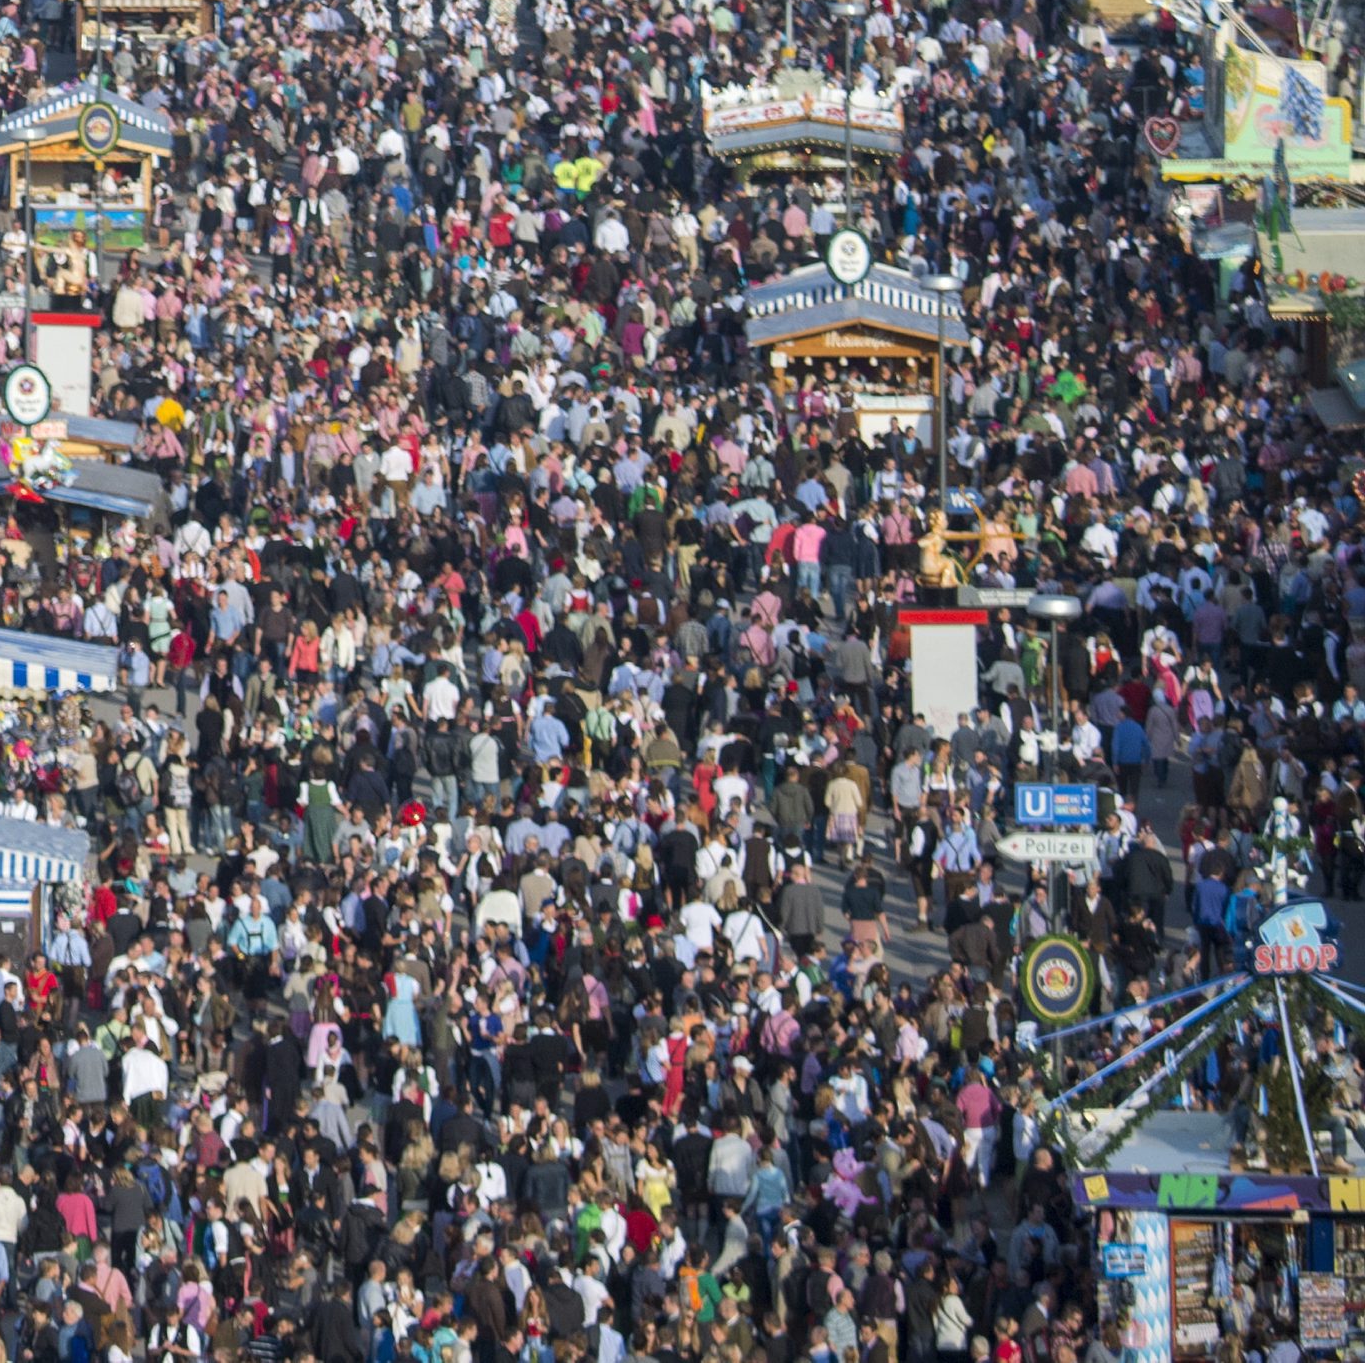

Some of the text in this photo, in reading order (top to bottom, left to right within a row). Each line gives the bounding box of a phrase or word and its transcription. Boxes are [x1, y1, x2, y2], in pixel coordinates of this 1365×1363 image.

[950, 491, 975, 509] WC
[1025, 791, 1047, 816] U
[1025, 837, 1086, 853] Polizei
[1255, 944, 1338, 973] SHOP
